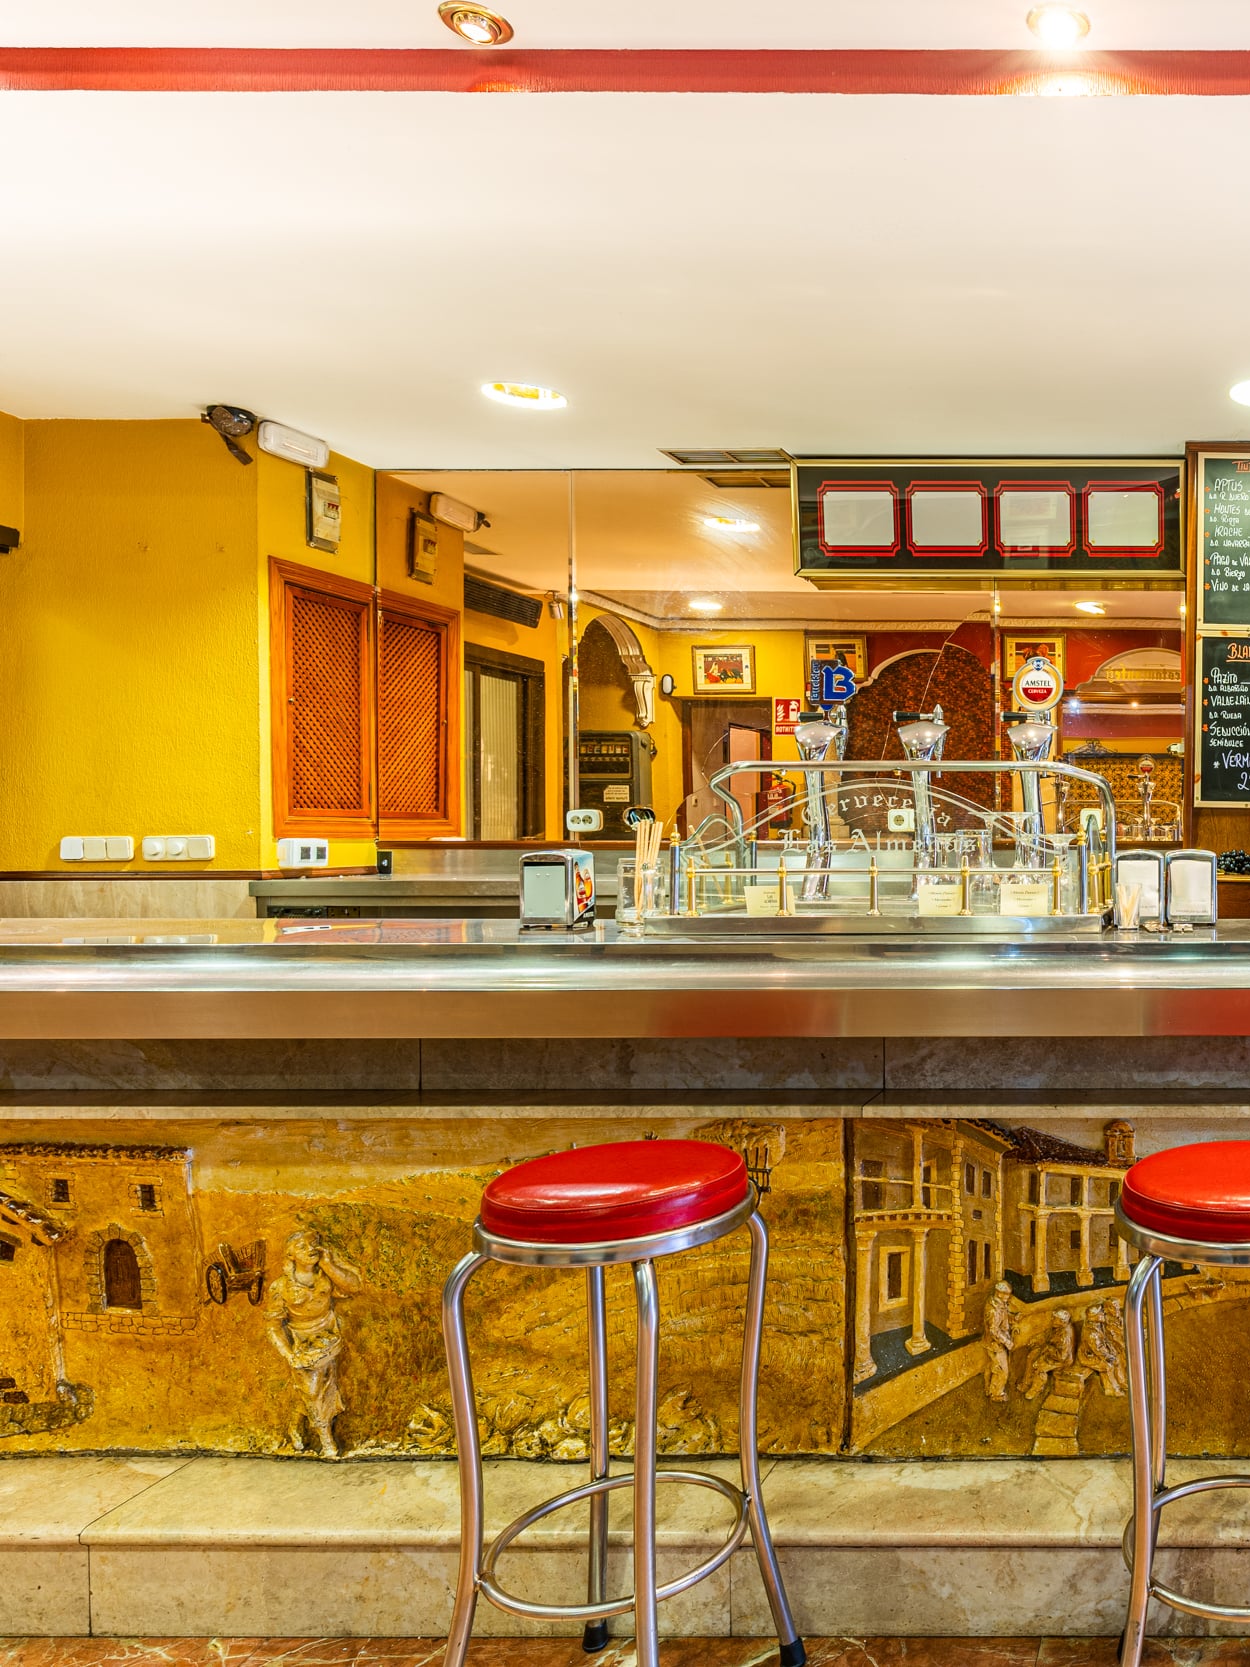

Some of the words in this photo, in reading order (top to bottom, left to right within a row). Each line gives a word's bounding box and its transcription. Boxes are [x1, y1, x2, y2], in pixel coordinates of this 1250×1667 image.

[1214, 478, 1243, 492] APTUS
[1214, 503, 1241, 515] MONTES
[1210, 579, 1229, 592] VINO
